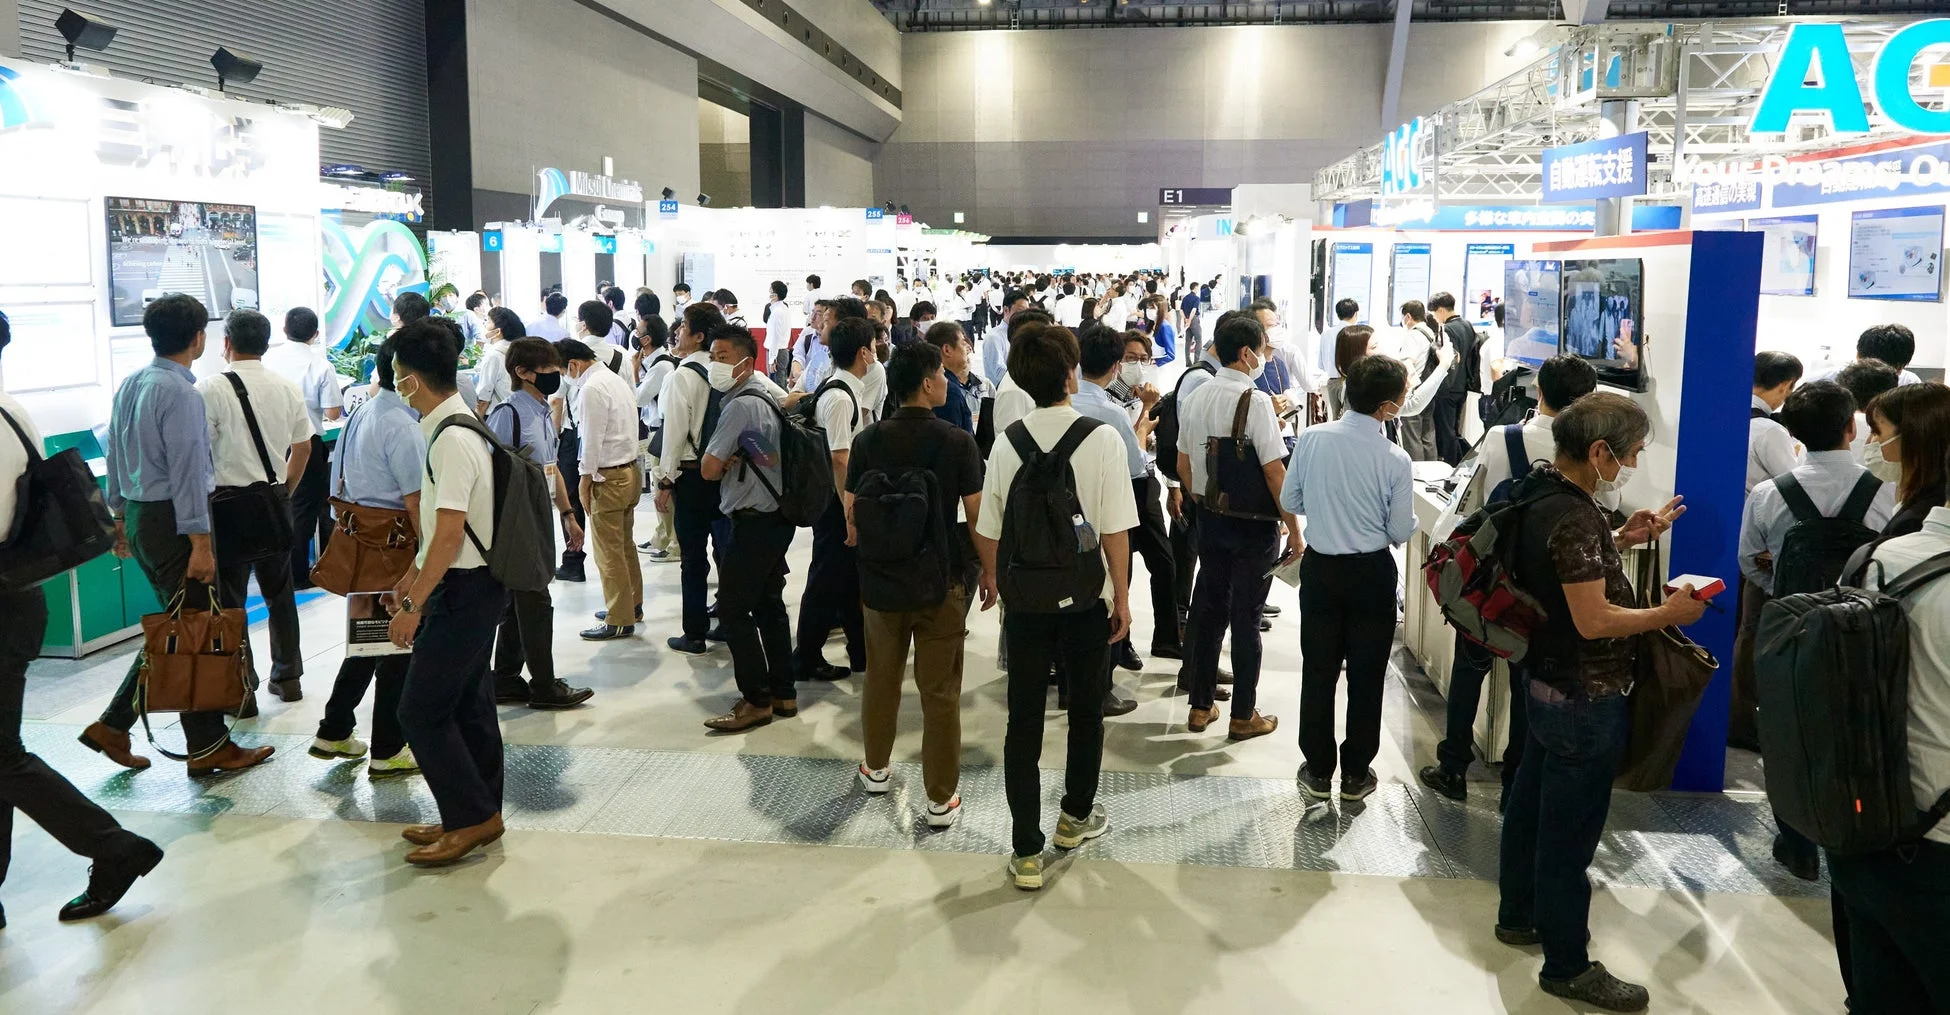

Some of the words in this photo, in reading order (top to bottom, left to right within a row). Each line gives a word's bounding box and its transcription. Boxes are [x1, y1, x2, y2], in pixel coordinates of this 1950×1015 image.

[1382, 116, 1424, 196] AGC
[1550, 147, 1633, 192] 自動運転支援
[1673, 154, 1761, 187] Your
[1164, 190, 1183, 203] E1
[661, 203, 677, 212] 254
[867, 210, 881, 218] 255
[489, 236, 498, 247] 6
[606, 241, 613, 251] 4
